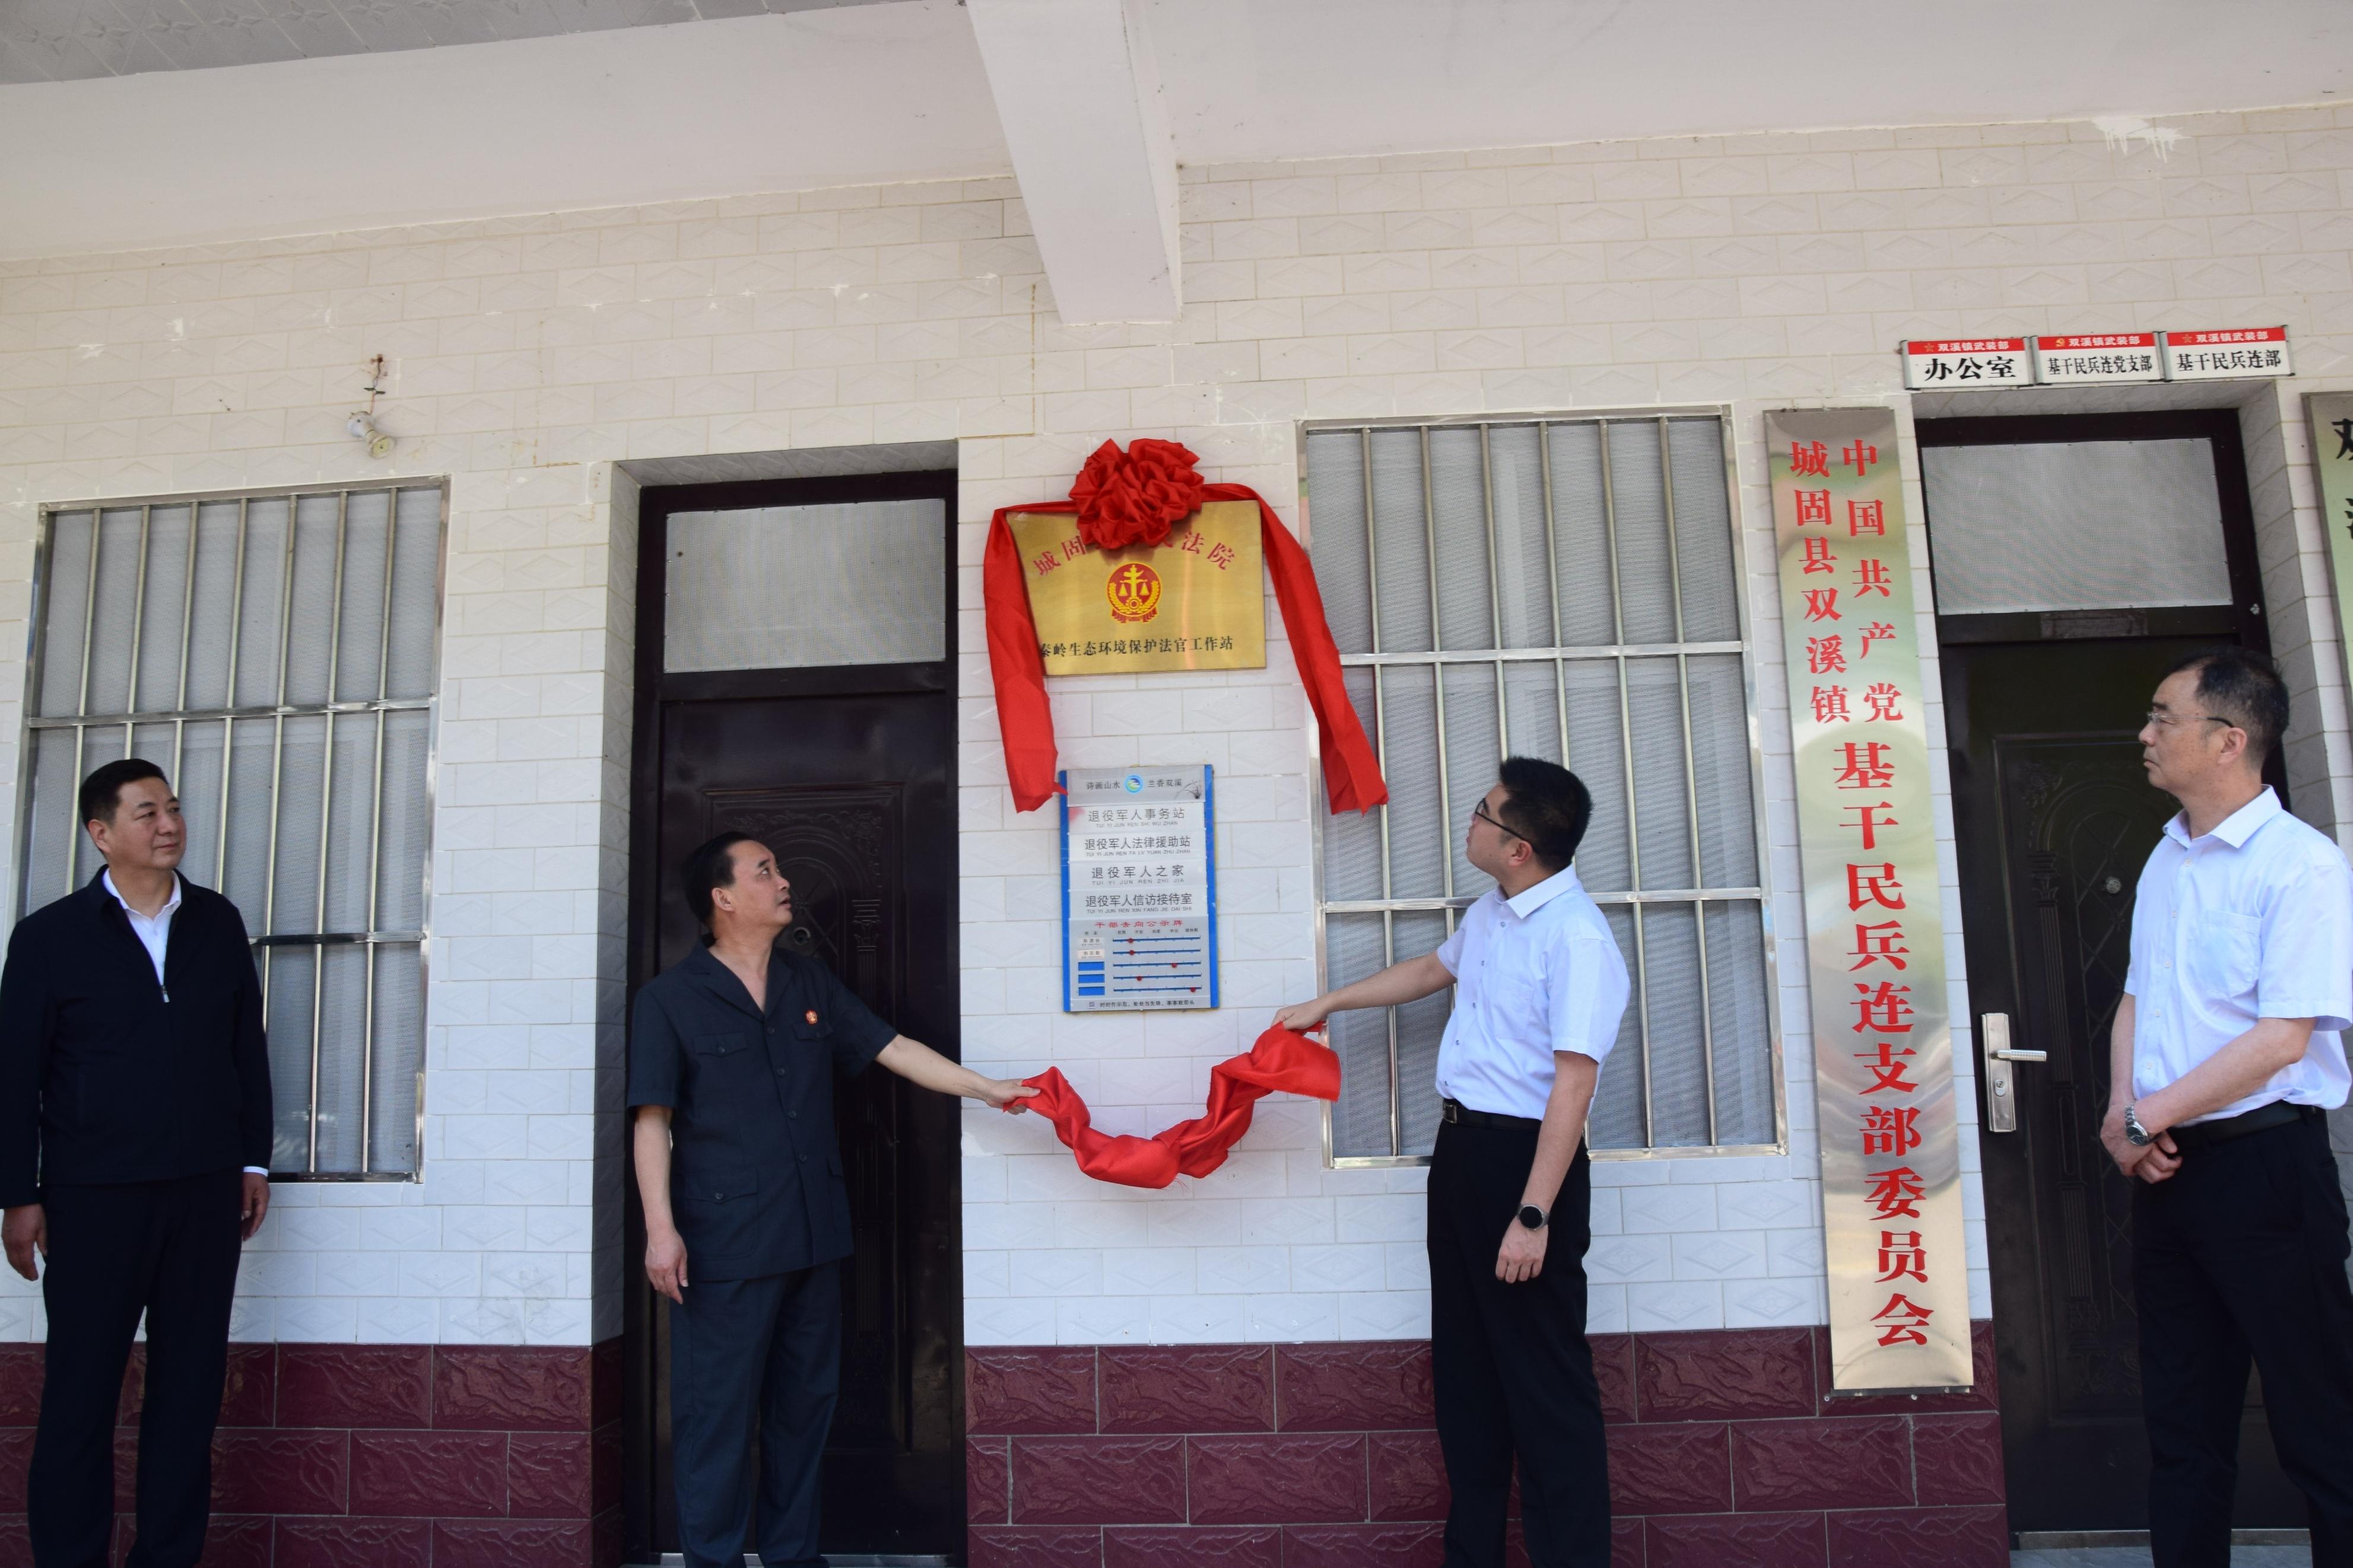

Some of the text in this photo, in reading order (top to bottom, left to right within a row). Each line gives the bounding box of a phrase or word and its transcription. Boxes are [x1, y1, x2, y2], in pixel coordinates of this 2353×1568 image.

[1938, 341, 2009, 352] 双溪镇武装部
[2068, 335, 2140, 347] 双溪镇武装部
[2196, 331, 2268, 344] 双溪镇武装部
[1925, 356, 2016, 381] 办公室
[2048, 355, 2152, 376] 基干民兵连党支部
[2177, 349, 2282, 372] 基干民兵连部
[1033, 530, 1236, 577] 城固法院
[1789, 440, 1852, 724] 城固县双溪镇
[1843, 439, 1904, 723] 中国共产党
[1040, 636, 1233, 658] 秦岭生态环境保护法官工作站
[1086, 781, 1120, 790] 诗画山水
[1088, 807, 1185, 822] 退役军人事务站
[1085, 835, 1190, 850] 退役军人法律援助站
[1092, 865, 1184, 879] 退役军人之家
[1085, 893, 1192, 907] 退役军人信访接待室
[1833, 742, 1934, 1347] 基干民兵连支部委员会
